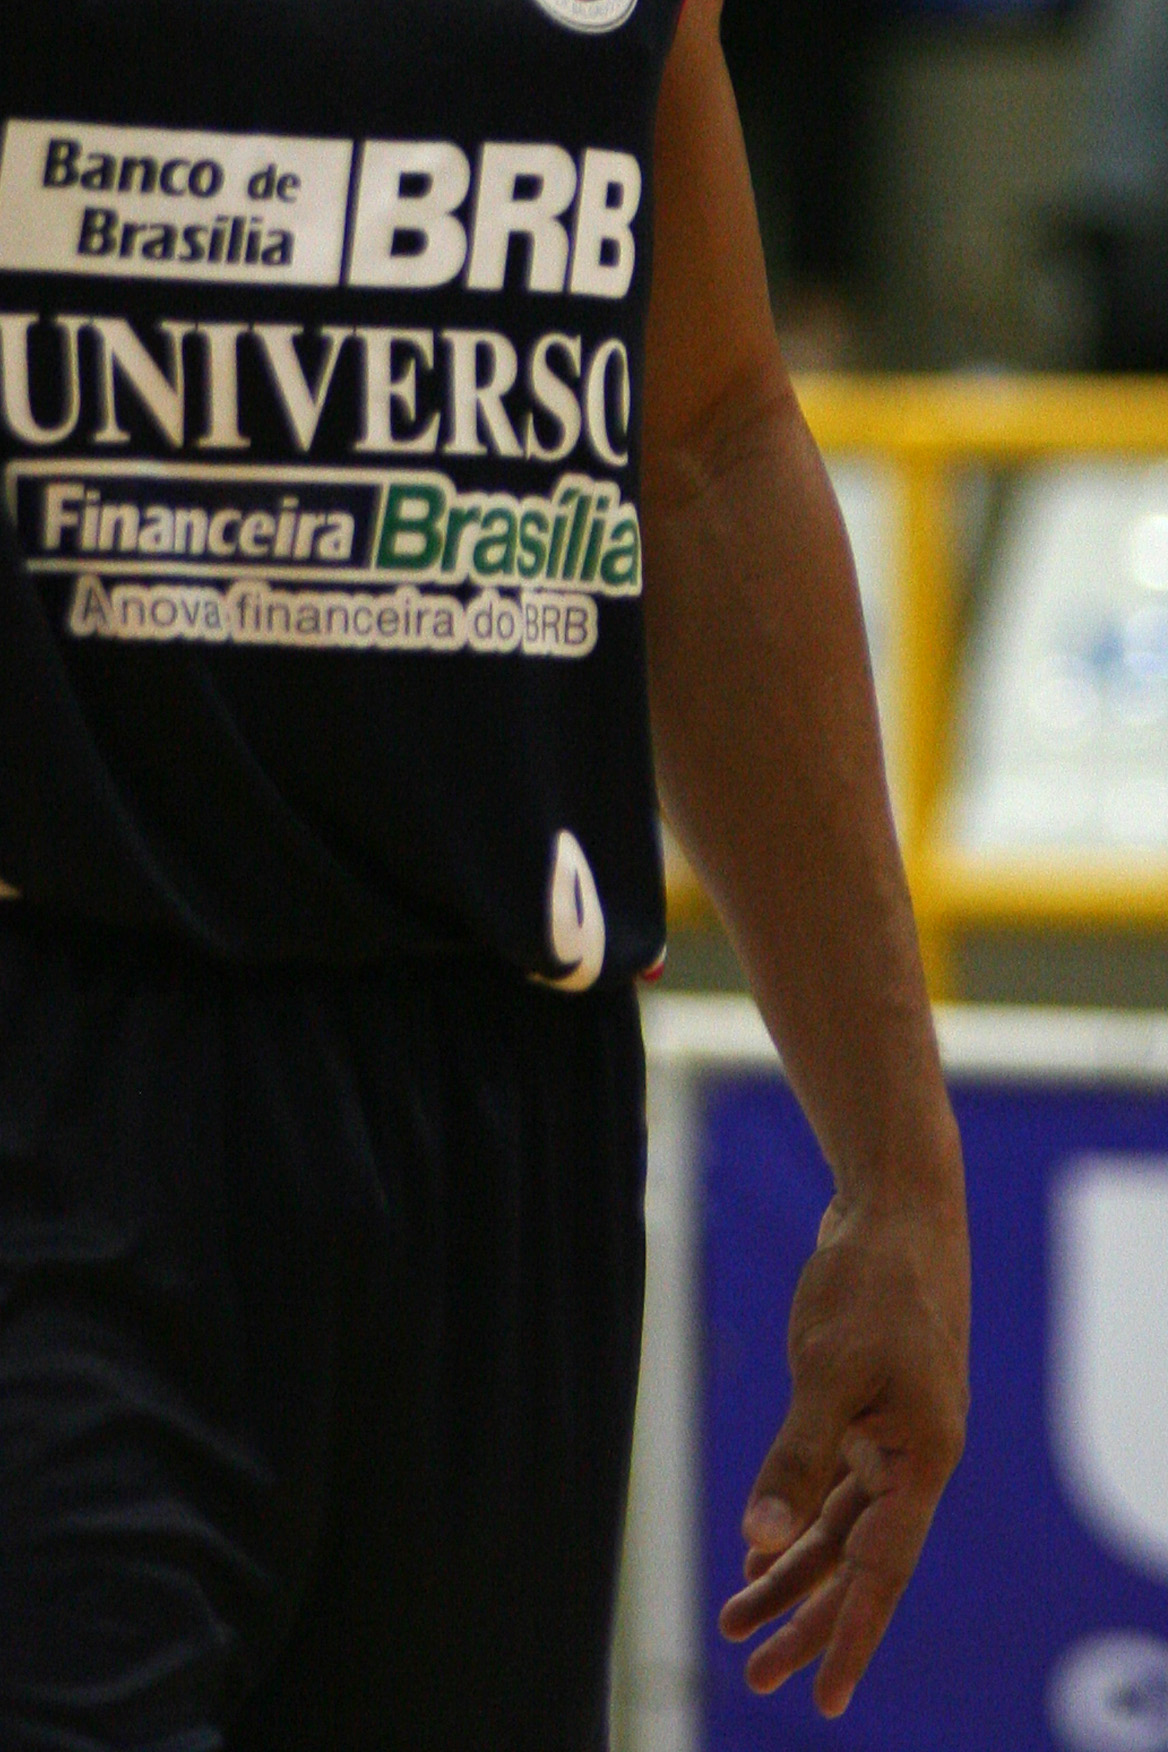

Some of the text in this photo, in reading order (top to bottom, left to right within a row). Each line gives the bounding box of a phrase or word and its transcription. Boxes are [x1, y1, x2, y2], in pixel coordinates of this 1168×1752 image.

[42, 137, 301, 203] Banco de
[76, 206, 296, 266] Brasília
[347, 140, 642, 299] BRB
[43, 482, 640, 586] Financeira Brasília
[80, 578, 589, 645] A nova financeira do BRB
[528, 828, 606, 992] 9
